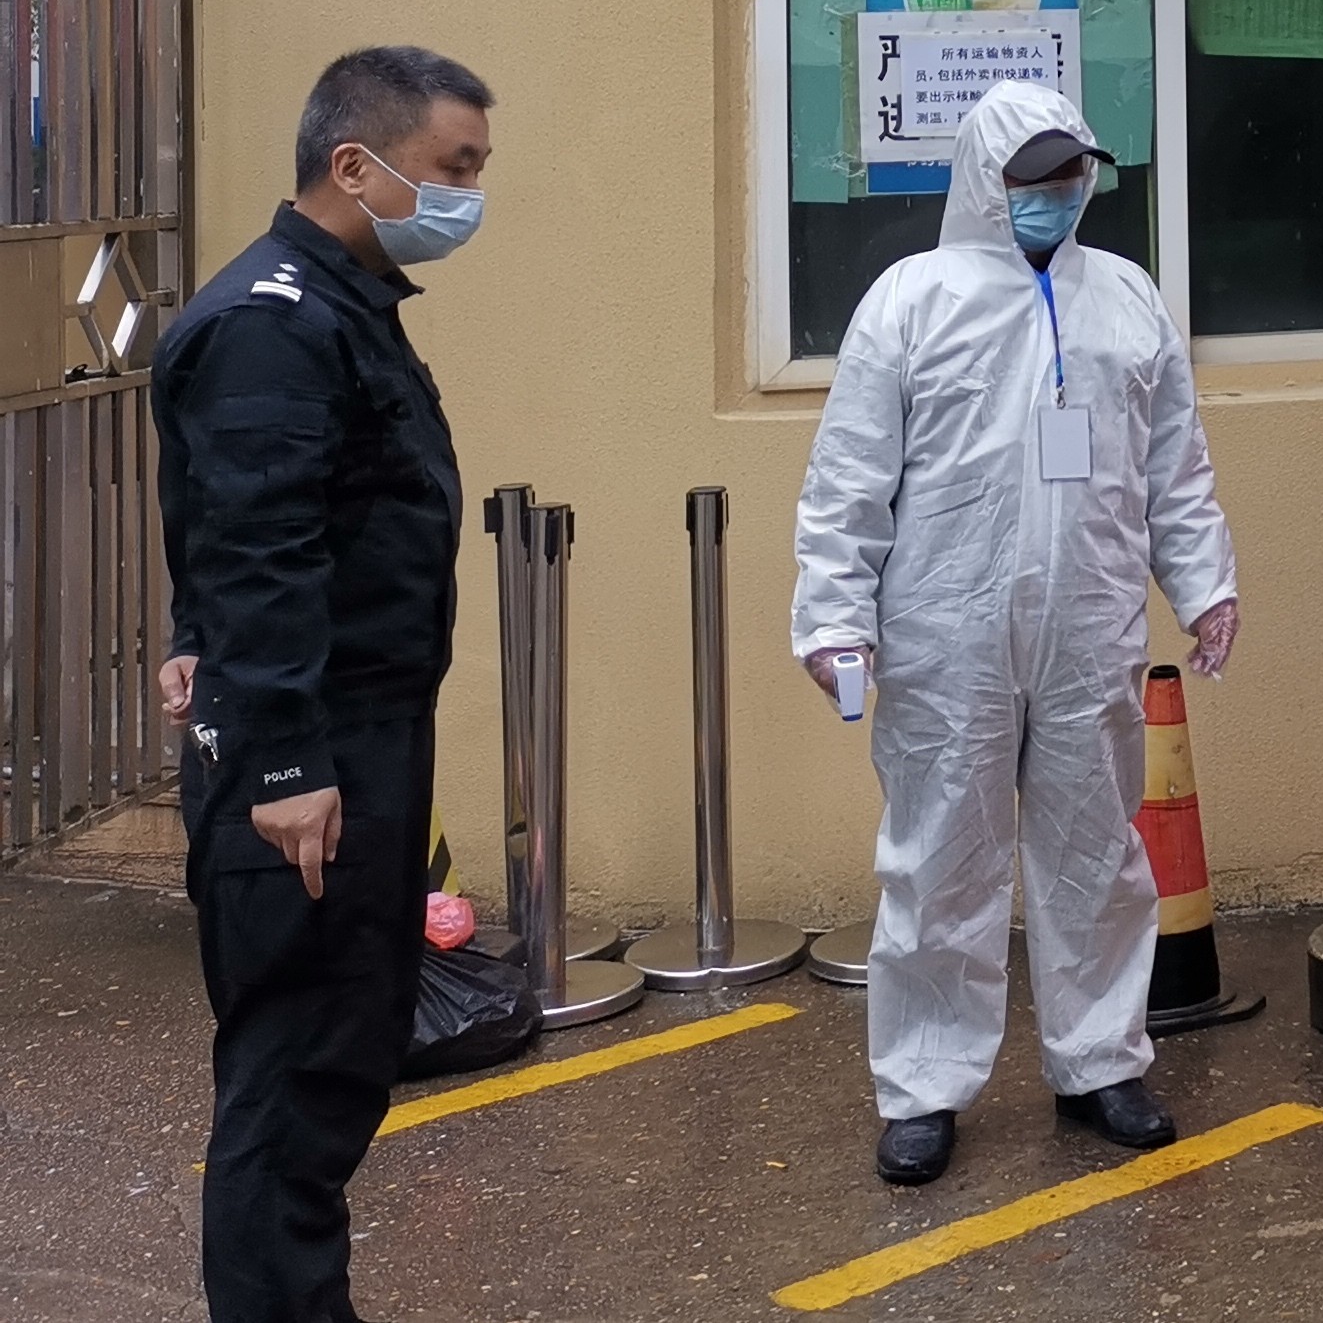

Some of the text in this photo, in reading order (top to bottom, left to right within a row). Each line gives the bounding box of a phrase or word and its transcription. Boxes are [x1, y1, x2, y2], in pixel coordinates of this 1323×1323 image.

[941, 44, 1044, 60] 所有运输物资人
[915, 89, 988, 104] 要出示核酸
[264, 765, 303, 785] POLICE
